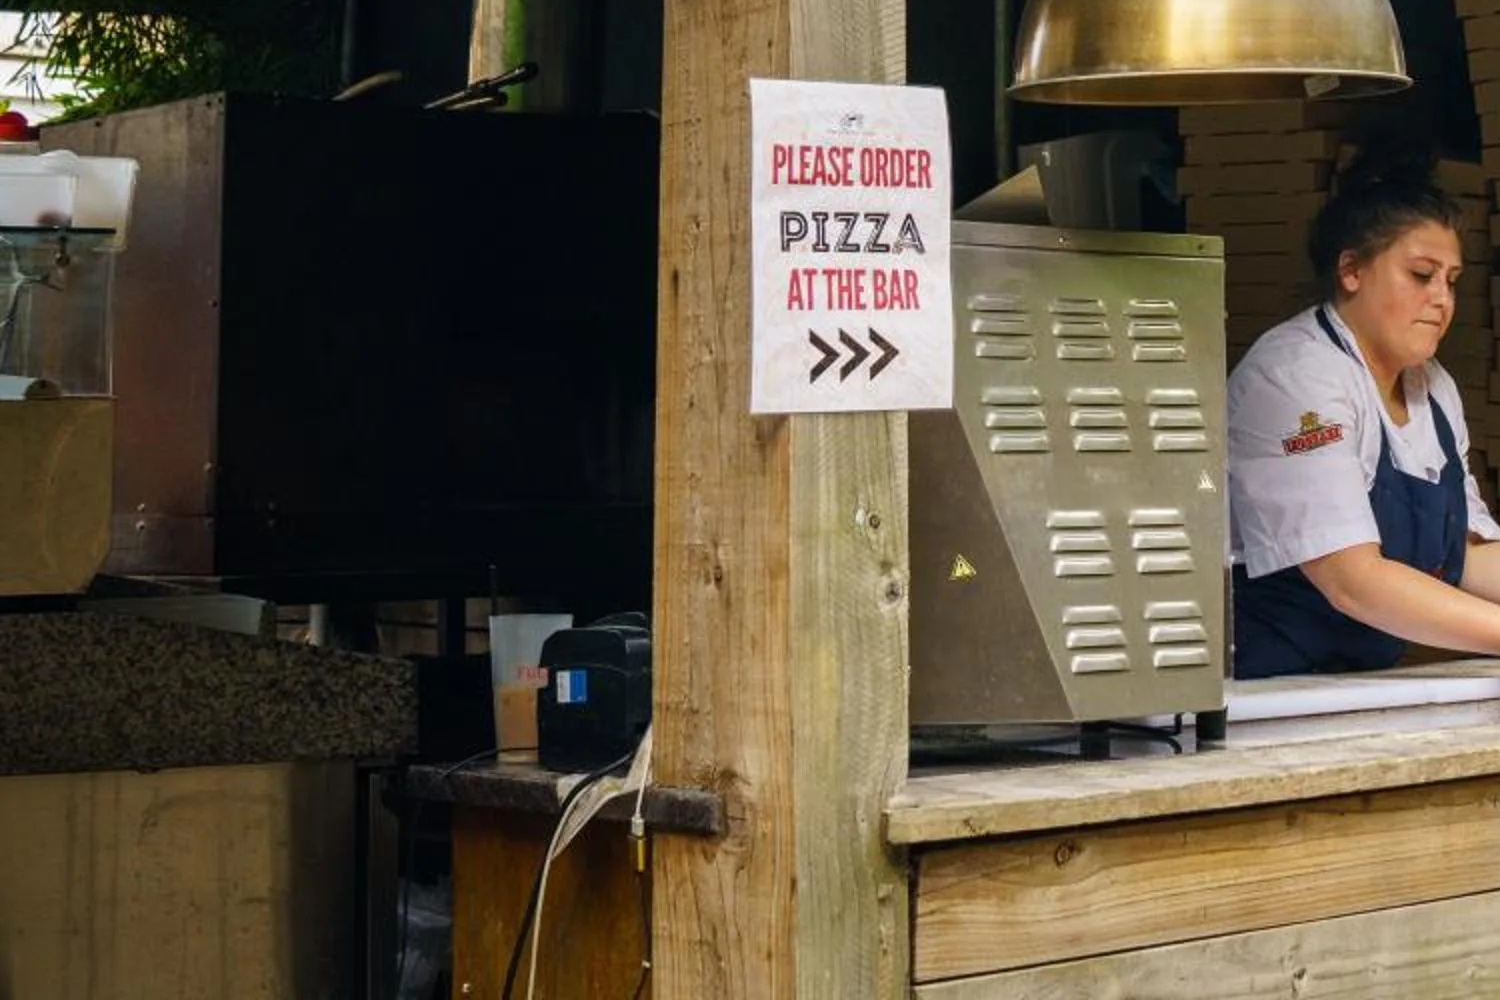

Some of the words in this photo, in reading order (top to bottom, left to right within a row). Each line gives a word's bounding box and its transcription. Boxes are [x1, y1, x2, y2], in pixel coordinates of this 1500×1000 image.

[771, 143, 855, 189] PLEASE
[860, 147, 933, 190] ORDER
[779, 211, 926, 254] PIZZA
[786, 267, 817, 312] AT
[821, 267, 867, 311] THE
[872, 267, 921, 311] BAR
